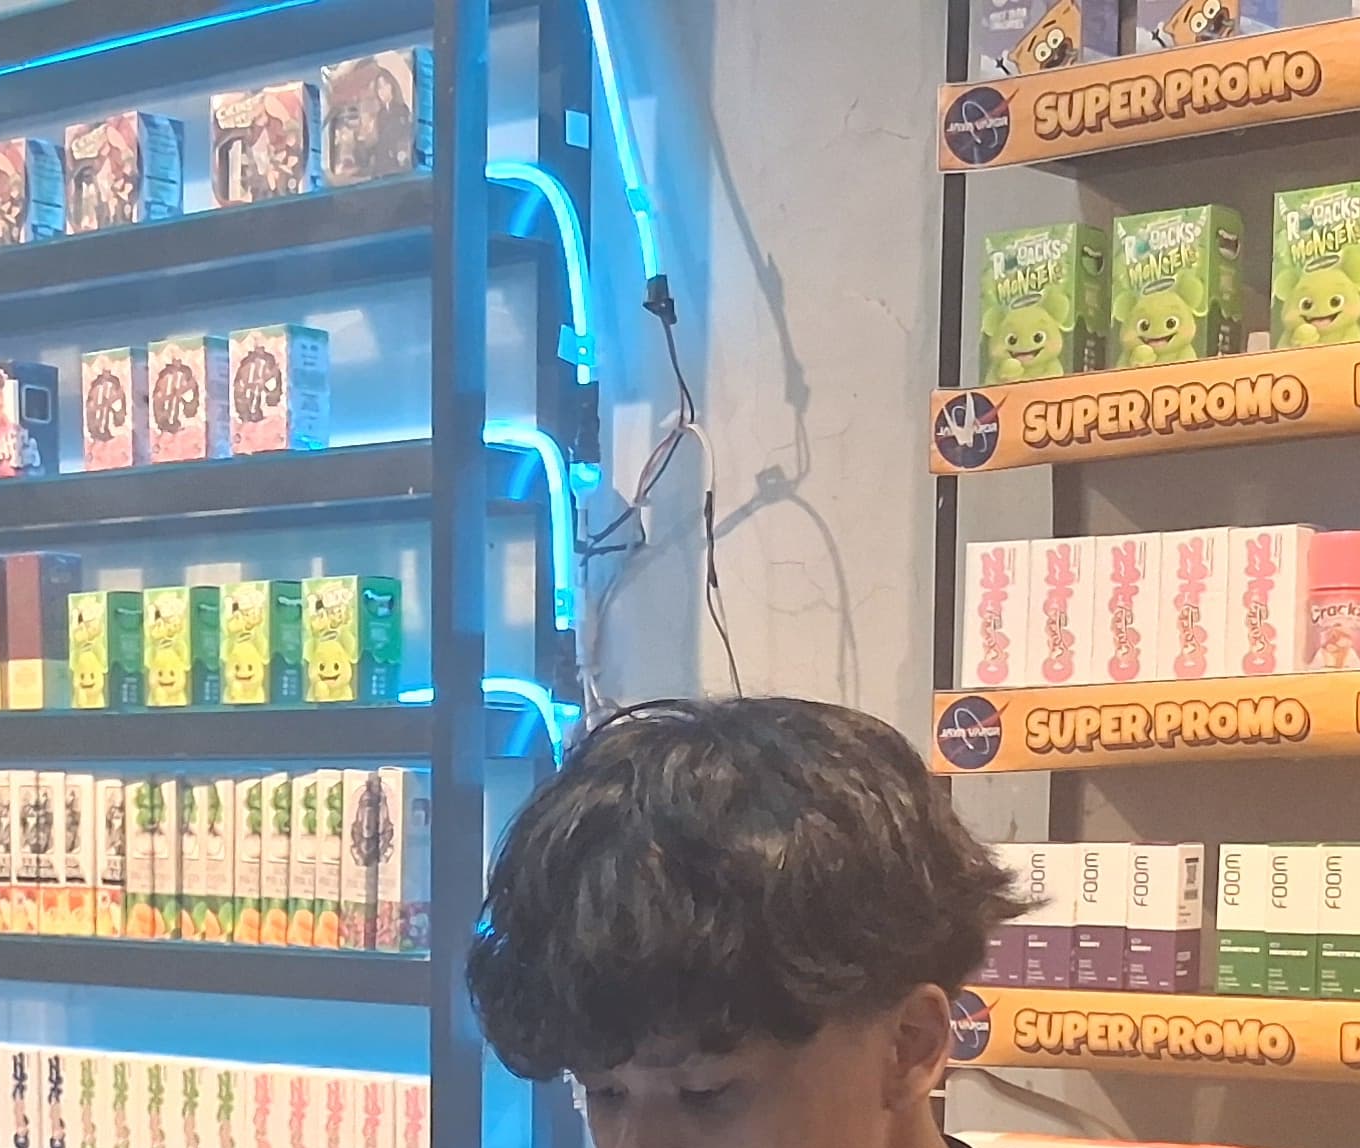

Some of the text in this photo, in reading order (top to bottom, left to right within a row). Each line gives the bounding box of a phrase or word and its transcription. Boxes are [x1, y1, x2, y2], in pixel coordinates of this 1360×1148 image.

[1034, 76, 1160, 140] SUPER
[1163, 52, 1322, 117] PROMO
[1023, 392, 1153, 449] SUPER
[1152, 374, 1309, 432] PROMO
[1025, 703, 1153, 752] SUPER
[1153, 697, 1310, 747] PROMO
[1083, 853, 1099, 902] FOOM
[1133, 855, 1150, 907] FOOM
[1224, 853, 1241, 906] FOOM
[1272, 855, 1289, 909] FOOM
[1325, 856, 1342, 910] FOOM
[1014, 1008, 1139, 1054] SUPER
[1140, 1014, 1295, 1065] PROMO
